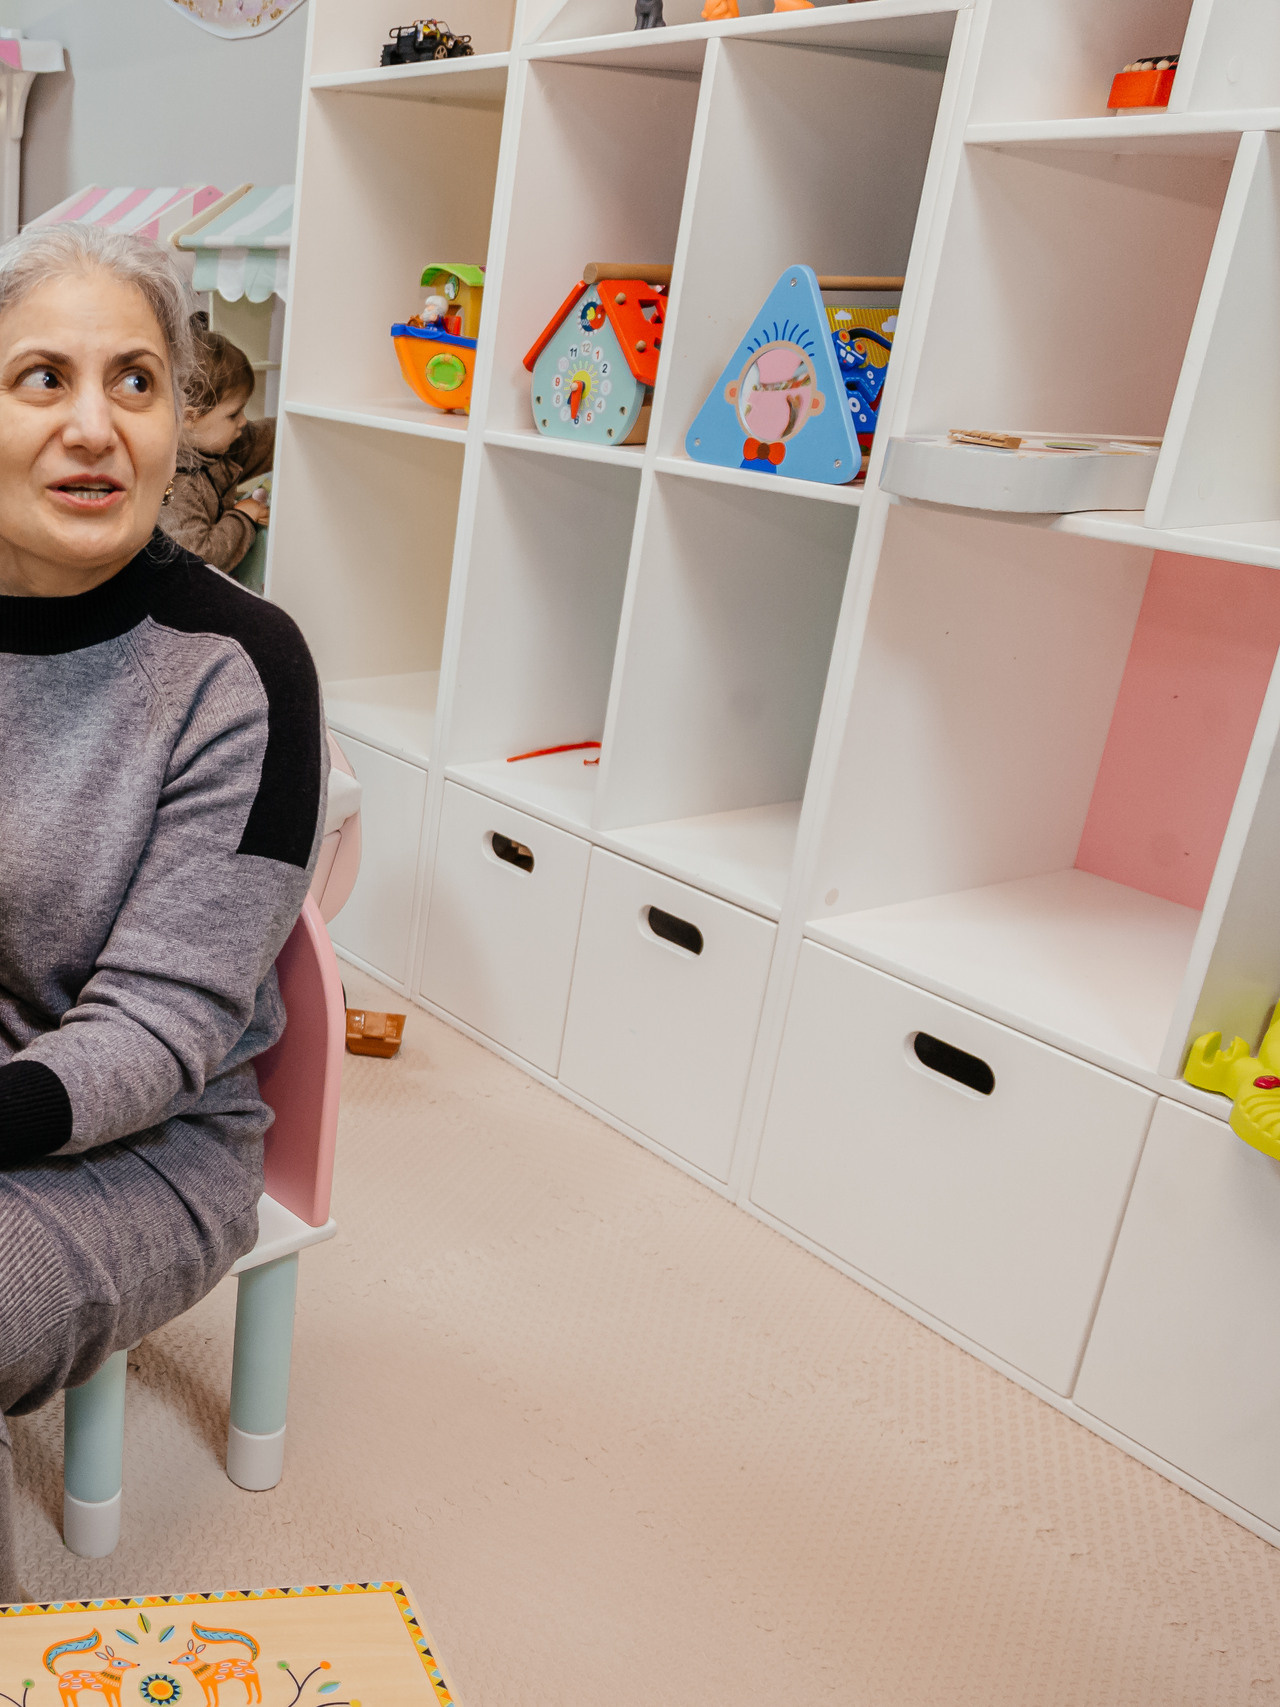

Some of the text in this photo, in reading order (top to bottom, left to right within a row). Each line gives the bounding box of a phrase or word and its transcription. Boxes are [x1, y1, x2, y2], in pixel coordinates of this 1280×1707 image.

[570, 348, 577, 357] 11
[582, 344, 590, 352] 12
[596, 350, 600, 360] 1
[602, 364, 608, 373] 2
[555, 377, 560, 387] 9
[597, 401, 602, 409] 4
[587, 412, 592, 421] 5
